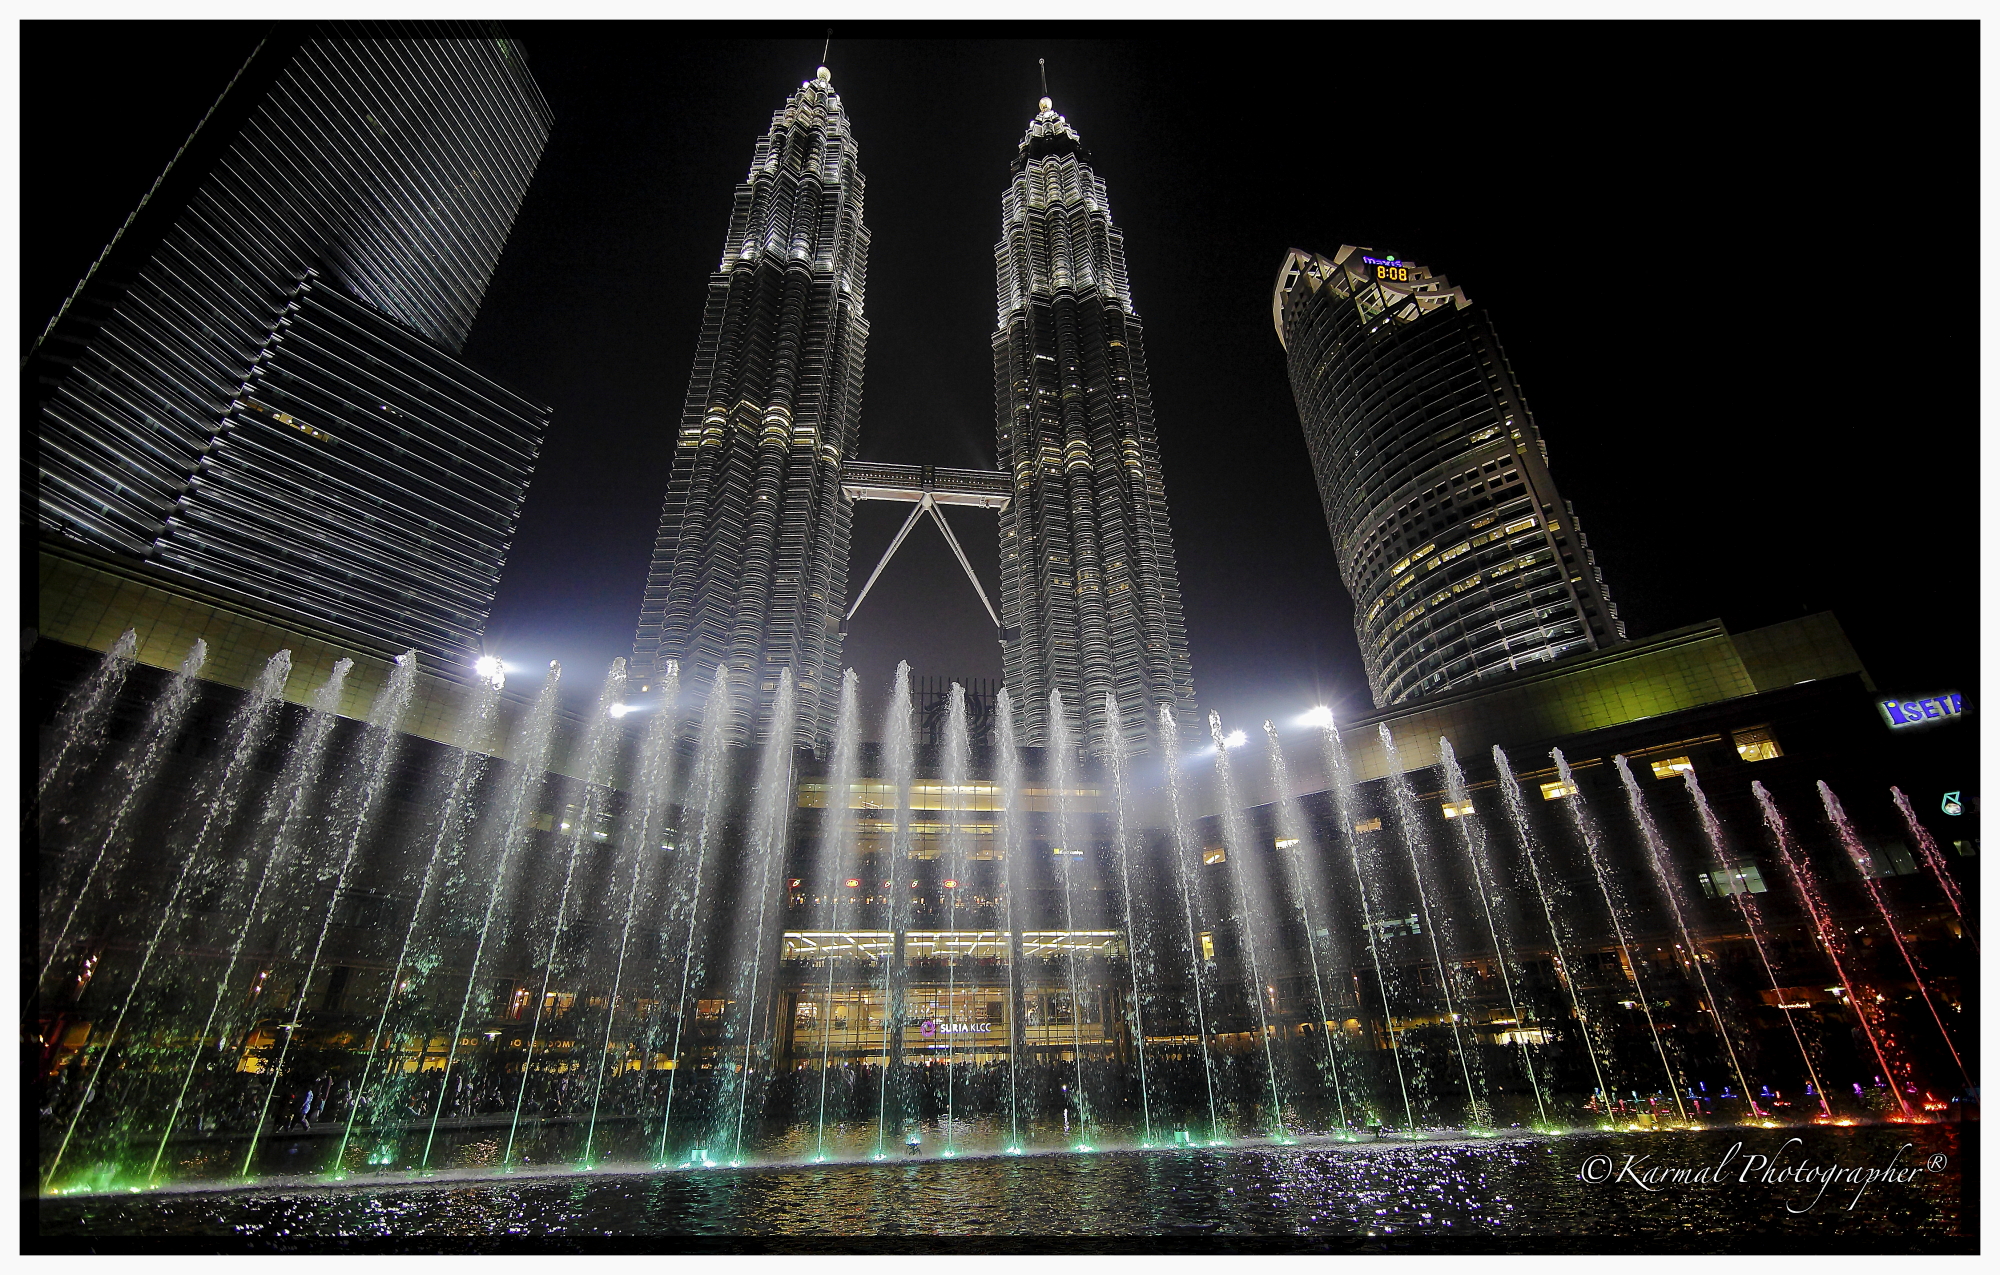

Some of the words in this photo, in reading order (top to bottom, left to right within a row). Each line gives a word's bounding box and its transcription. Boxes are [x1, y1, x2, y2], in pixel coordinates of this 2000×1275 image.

[1377, 265, 1407, 281] 8:08
[940, 1022, 969, 1035] SURIA
[970, 1022, 992, 1033] KLCC
